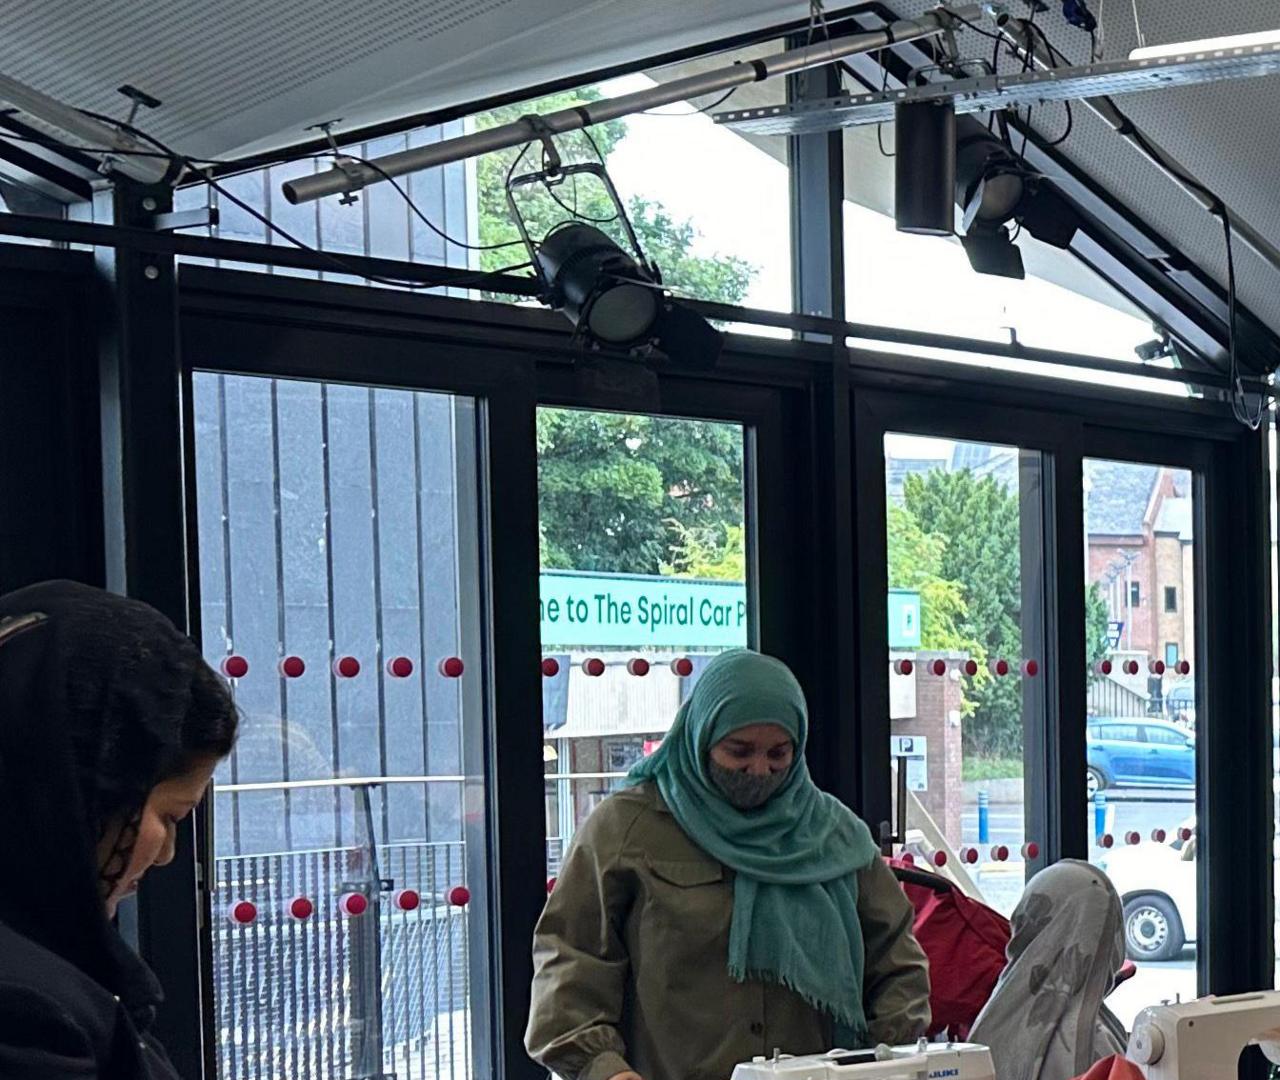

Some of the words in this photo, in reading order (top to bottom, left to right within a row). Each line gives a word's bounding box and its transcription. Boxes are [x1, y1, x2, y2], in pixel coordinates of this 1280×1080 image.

[566, 594, 588, 623] to
[594, 592, 632, 624] The
[637, 594, 694, 632] Spiral
[699, 598, 732, 626] Car
